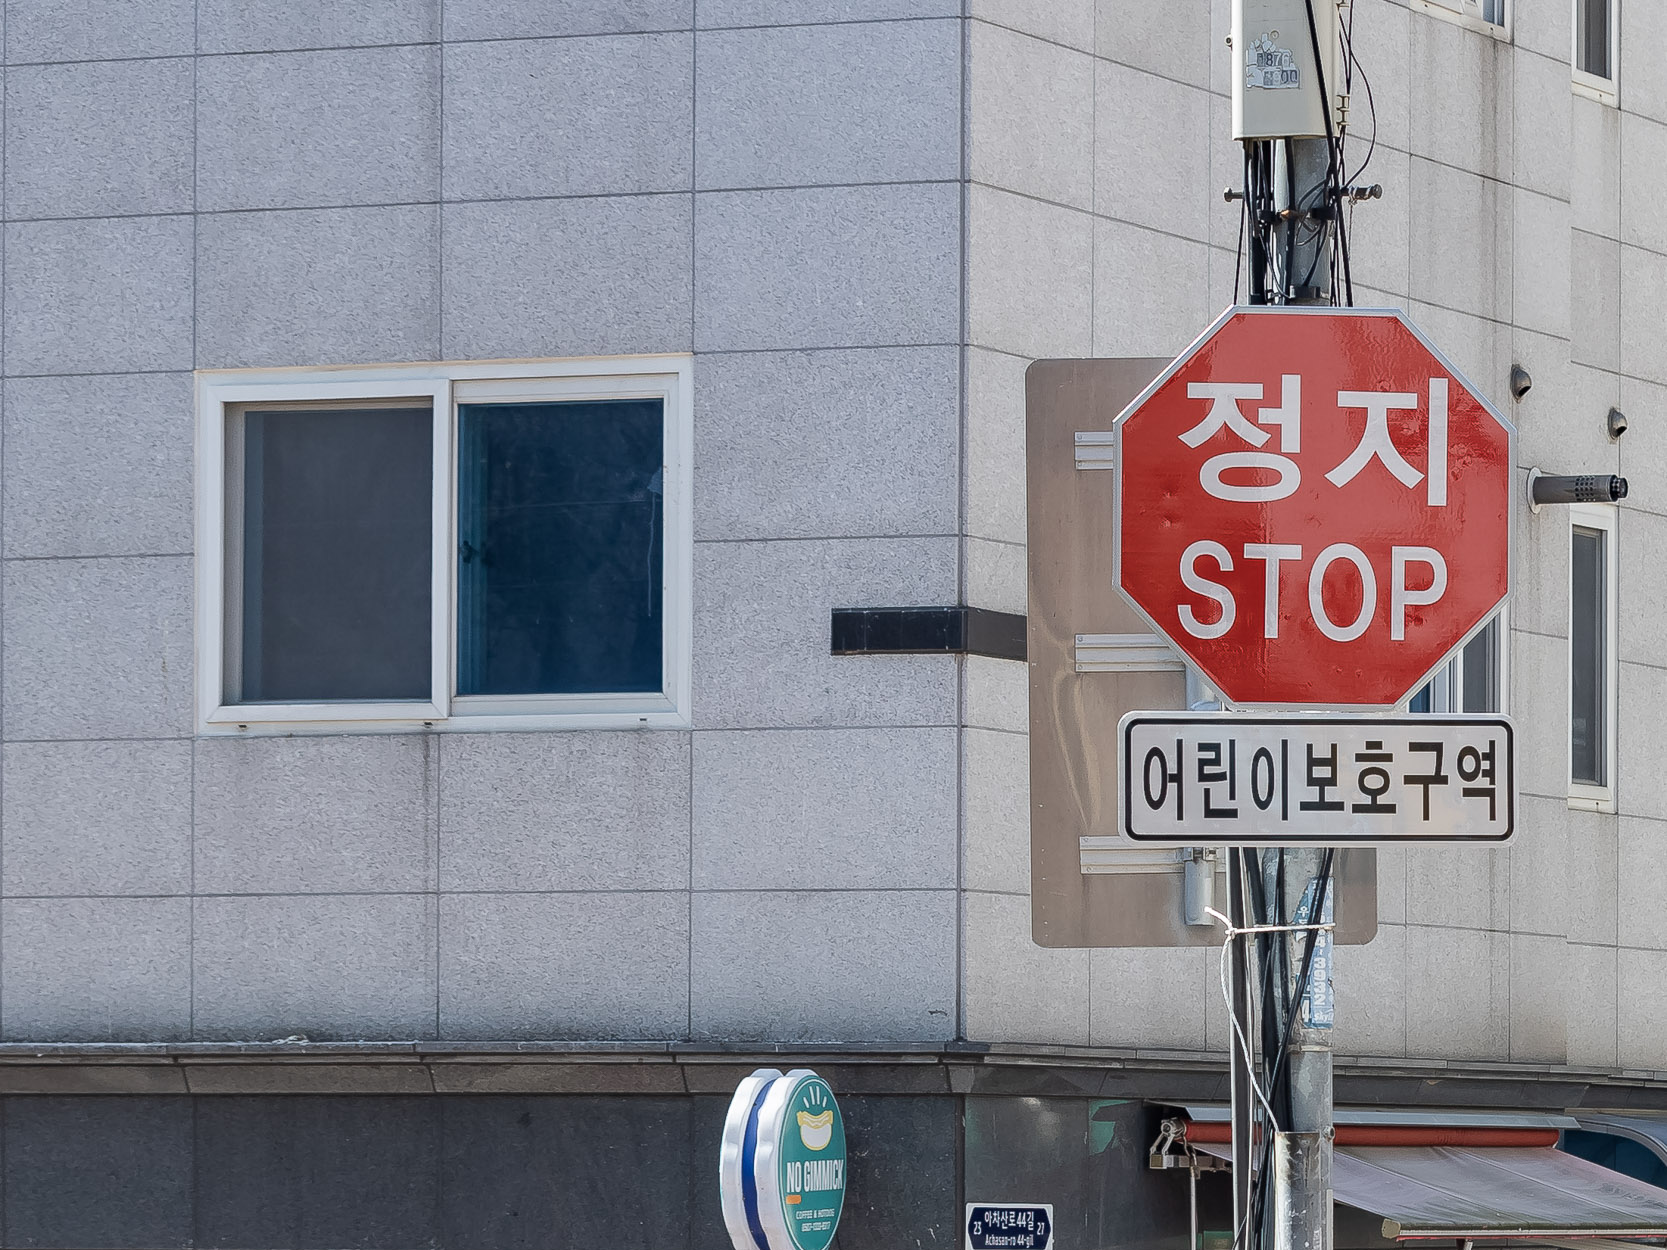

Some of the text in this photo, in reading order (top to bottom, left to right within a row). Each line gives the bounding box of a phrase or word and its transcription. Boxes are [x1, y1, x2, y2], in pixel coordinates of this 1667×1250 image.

[1178, 374, 1449, 507] 정지
[1177, 540, 1448, 643] STOP
[1143, 737, 1497, 823] 어린이보호구역
[786, 1159, 844, 1193] NO GIMMICK
[973, 1221, 982, 1235] 23
[984, 1210, 1034, 1231] 아차산로44길
[1036, 1222, 1045, 1235] 27
[984, 1233, 1034, 1248] Achasan-ro 44-gil
